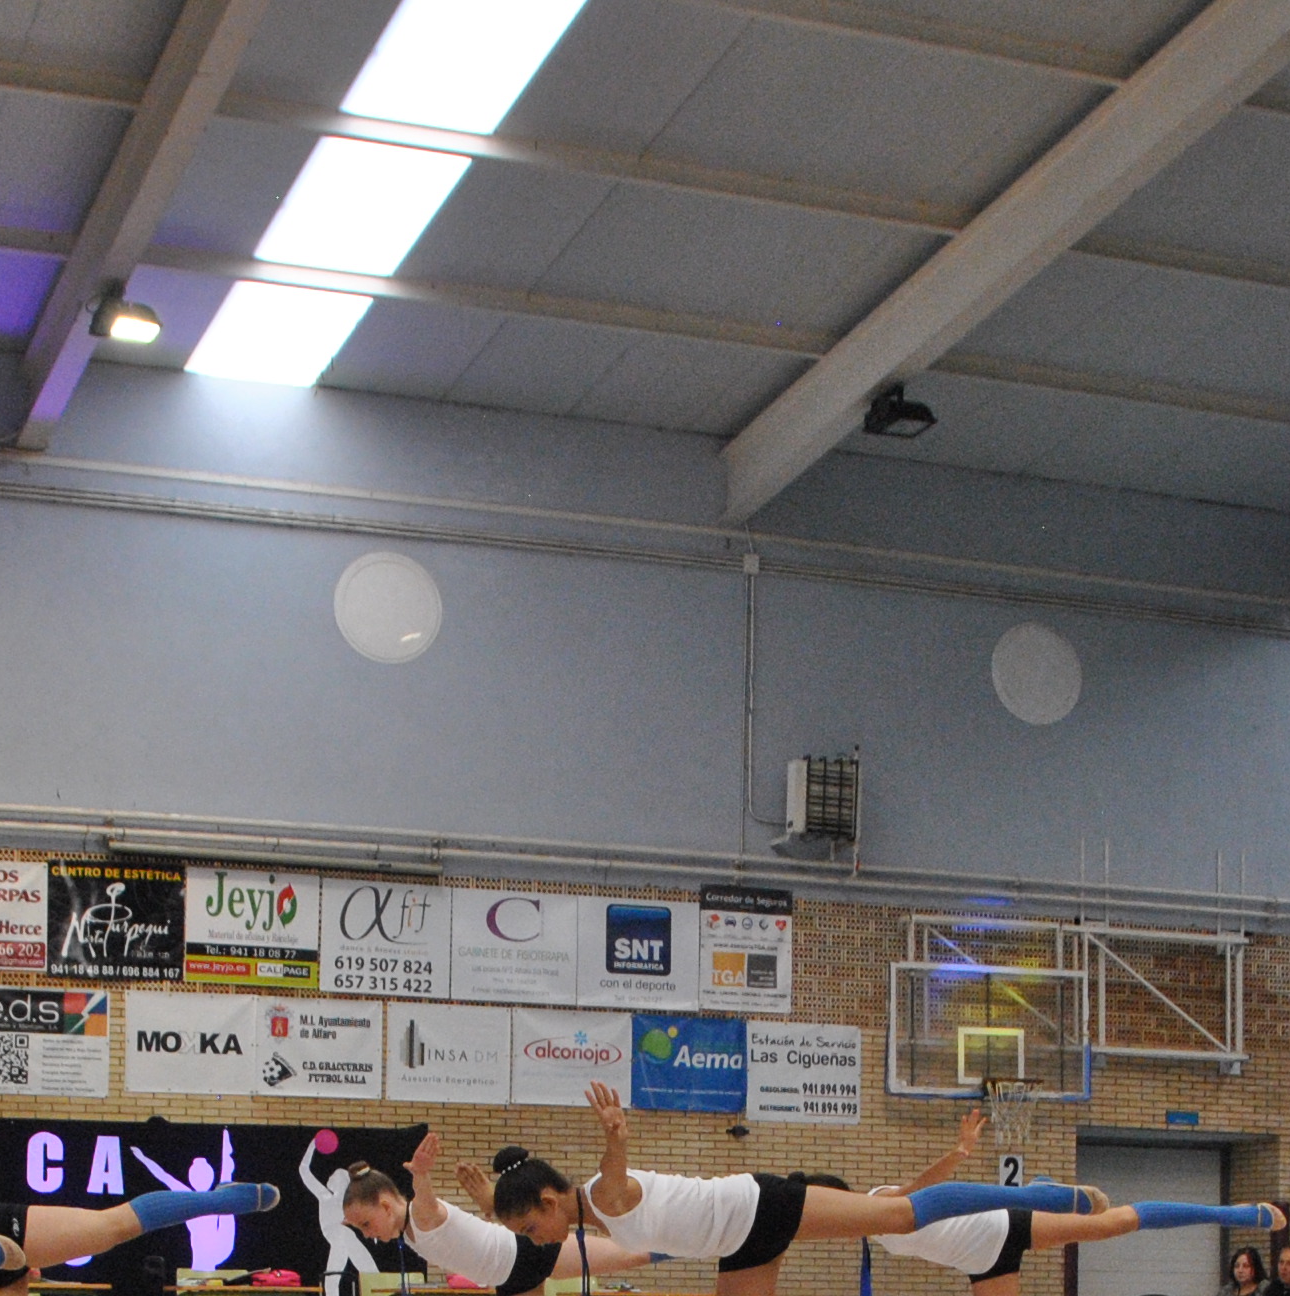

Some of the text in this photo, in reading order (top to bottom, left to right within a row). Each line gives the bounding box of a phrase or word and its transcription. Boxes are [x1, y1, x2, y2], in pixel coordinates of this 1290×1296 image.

[52, 865, 101, 877] CENTRO
[105, 868, 121, 878] DE
[206, 871, 297, 932] Jeyjo
[705, 892, 742, 904] Corredor
[744, 896, 755, 905] de
[756, 897, 788, 908] Seguros
[18, 943, 41, 957] 202
[230, 946, 248, 957] 941
[253, 947, 264, 957] 18
[268, 948, 280, 958] 08
[284, 949, 297, 959] 77
[501, 948, 512, 960] DE
[516, 949, 569, 962] FISIOTERAPIA
[614, 937, 664, 960] SNT
[51, 964, 69, 974] 941
[73, 965, 84, 974] 18
[163, 968, 180, 978] 167
[189, 961, 247, 973] www.jeyjo.es
[334, 956, 432, 975] 619 507 824
[334, 974, 432, 993] 657 315 422
[712, 970, 745, 985] TGA
[600, 979, 676, 992] con el deporte
[318, 1015, 371, 1028] Ayuntamiento
[300, 1028, 337, 1039] de Alfaro
[752, 1033, 857, 1049] Estación de Servicio
[428, 1048, 498, 1063] INSA DM
[673, 1045, 743, 1070] Aema
[751, 1049, 778, 1063] Las
[308, 1073, 366, 1084] FUTBOL SALA
[802, 1082, 817, 1095] 941
[820, 1083, 837, 1095] 894
[840, 1084, 857, 1096] 994
[803, 1101, 818, 1113] 941
[821, 1102, 838, 1114] 894
[841, 1103, 857, 1114] 993
[1004, 1156, 1019, 1186] 2
